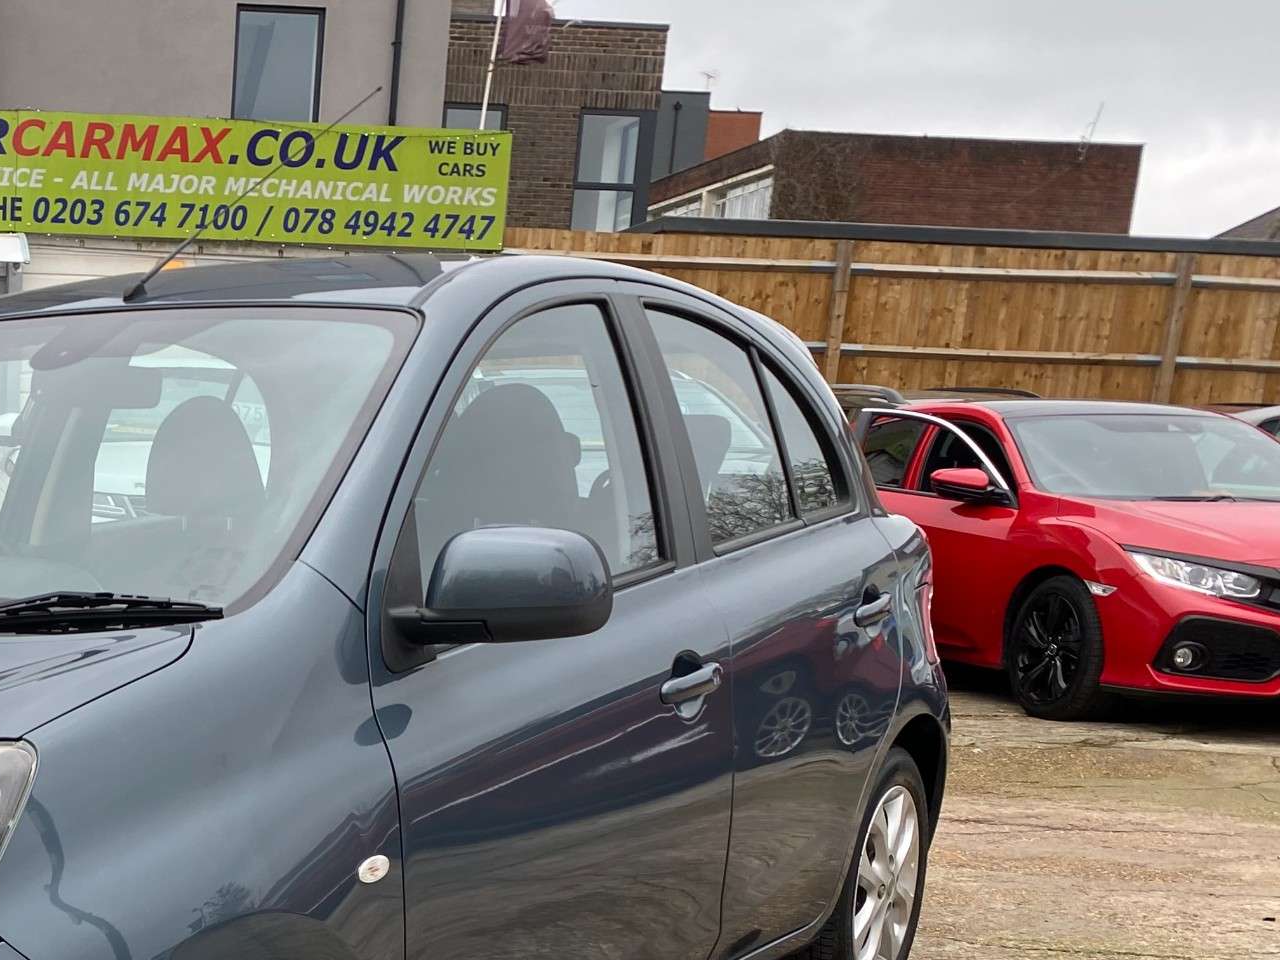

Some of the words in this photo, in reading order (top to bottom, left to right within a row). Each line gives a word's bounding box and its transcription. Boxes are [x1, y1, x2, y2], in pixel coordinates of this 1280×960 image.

[428, 140, 457, 155] WE
[463, 141, 501, 157] BUY
[438, 162, 487, 178] CARS
[70, 170, 119, 191] ALL
[127, 172, 217, 195] MAJOR
[224, 176, 392, 203] MECHANICAL
[402, 184, 498, 207] WORKS
[32, 197, 105, 225] 0203
[114, 200, 167, 228] 674
[176, 203, 248, 231] 7100
[282, 207, 337, 235] 078
[344, 210, 415, 237] 4942
[423, 213, 496, 240] 4747
